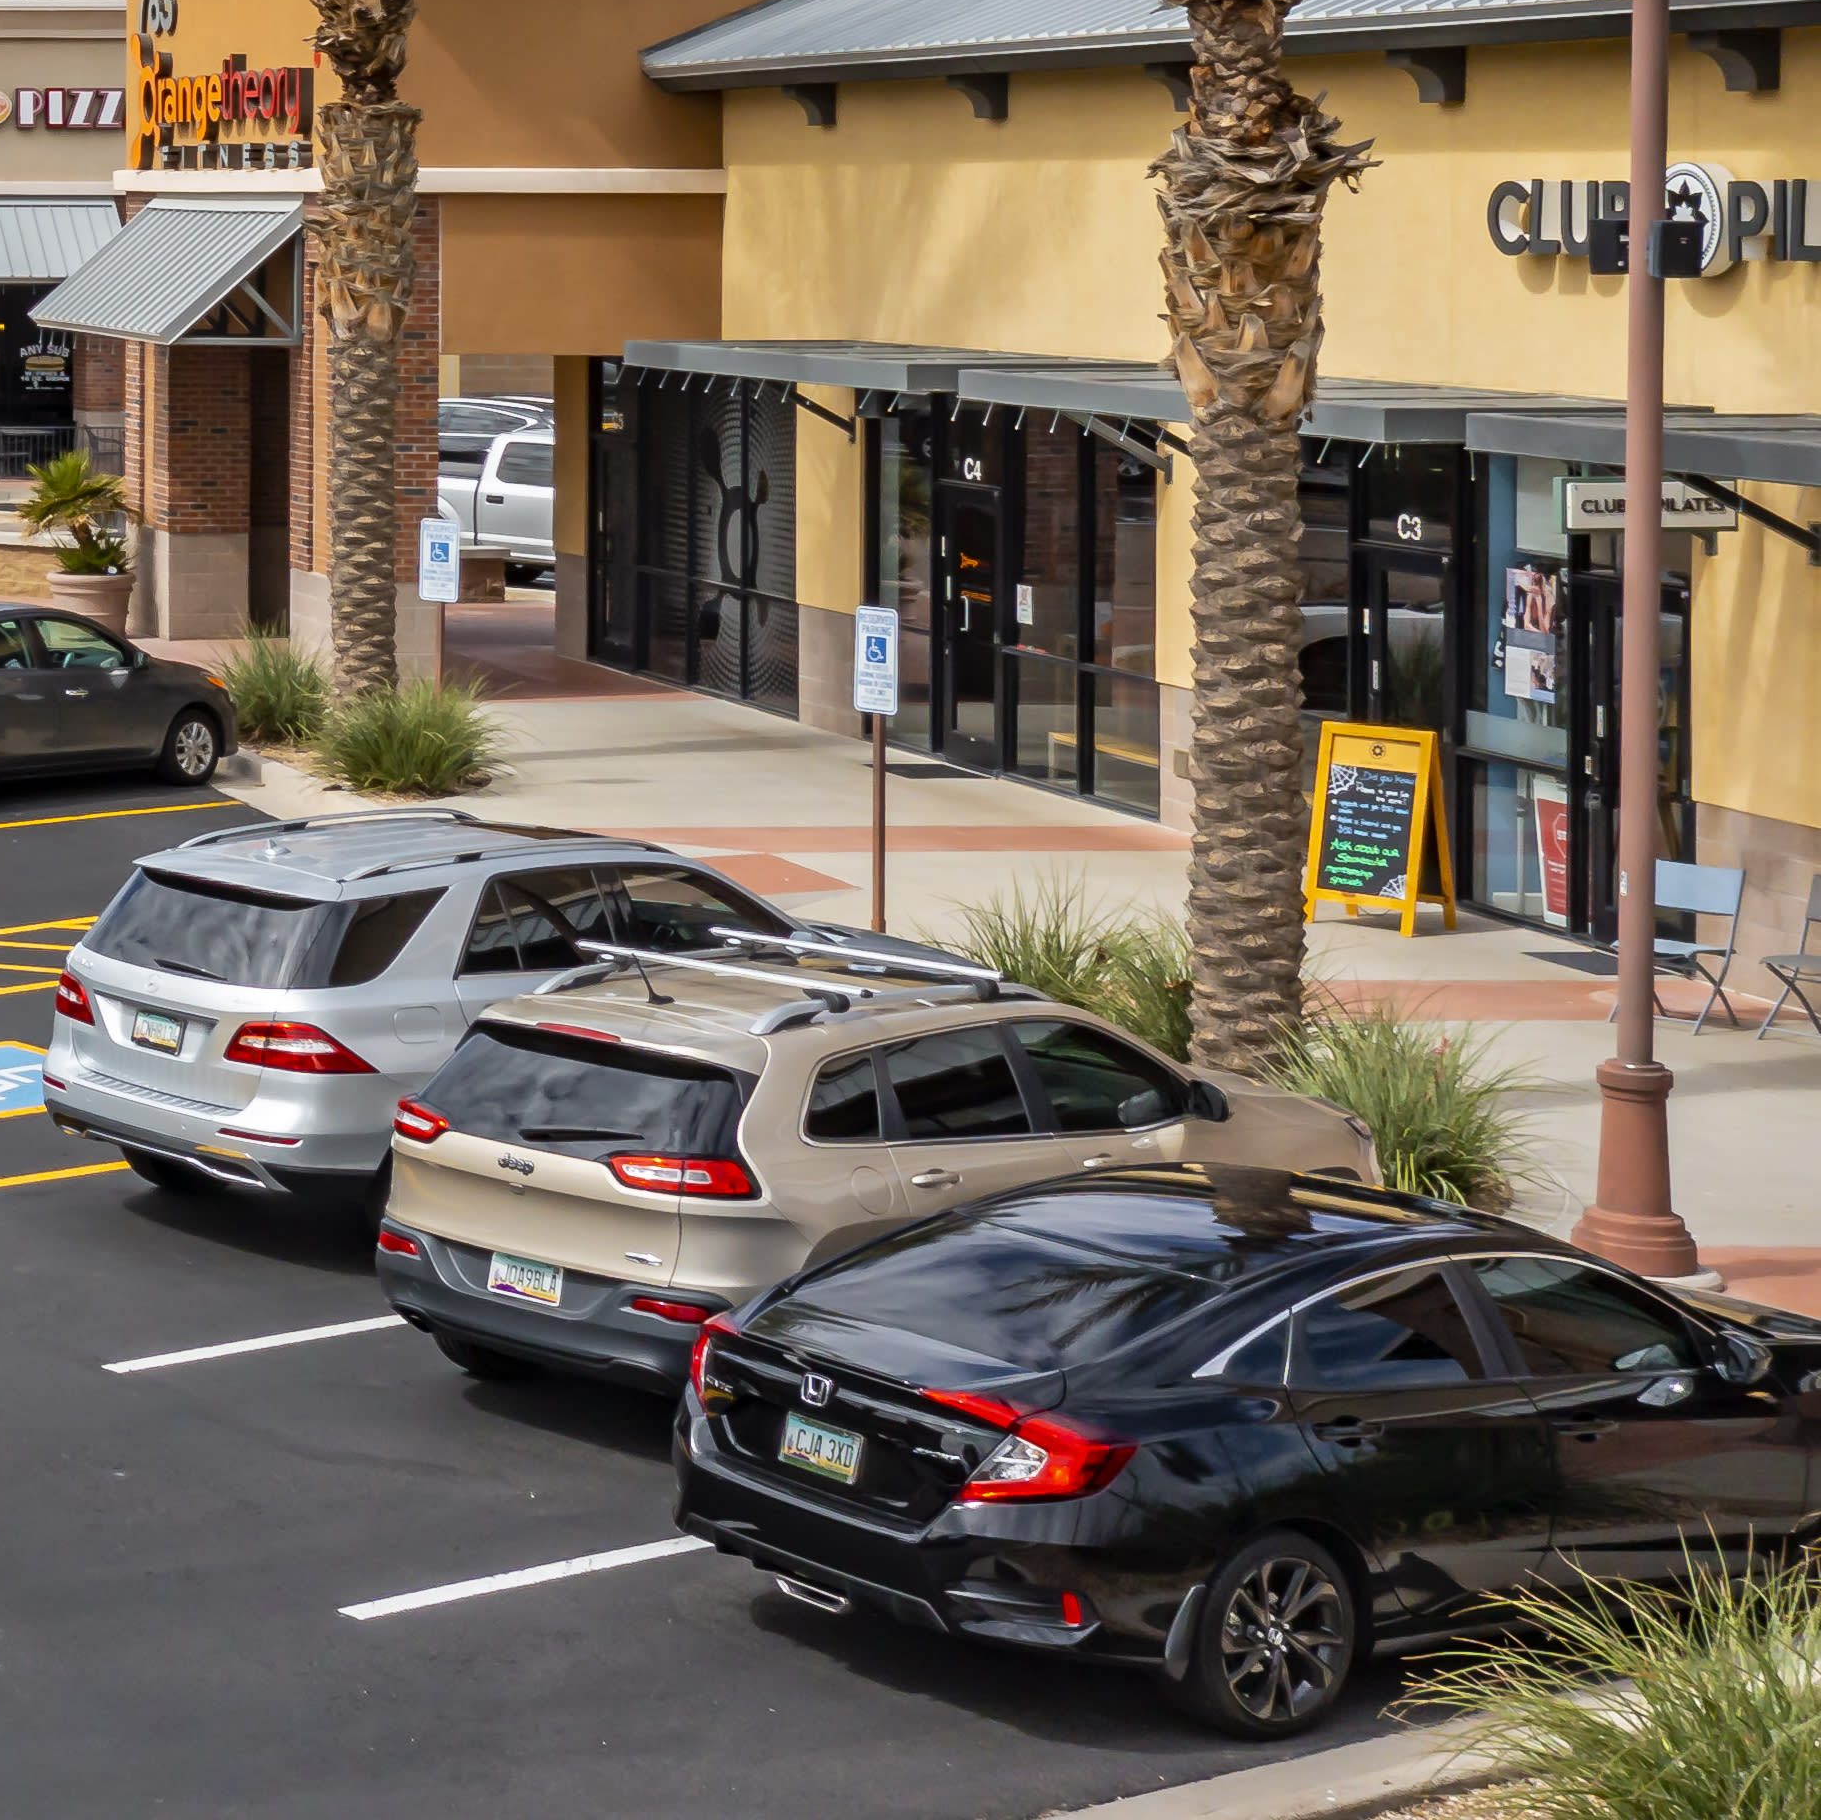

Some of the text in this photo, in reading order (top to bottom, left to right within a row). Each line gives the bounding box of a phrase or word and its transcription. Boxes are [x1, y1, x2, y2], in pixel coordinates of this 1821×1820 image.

[15, 86, 126, 130] PIZZ
[161, 141, 305, 169] FITNESS
[47, 344, 70, 357] SUB
[964, 458, 982, 481] C4
[1396, 513, 1422, 541] C3
[497, 1152, 535, 1177] Jeep
[796, 1428, 854, 1469] CJA 3XD
